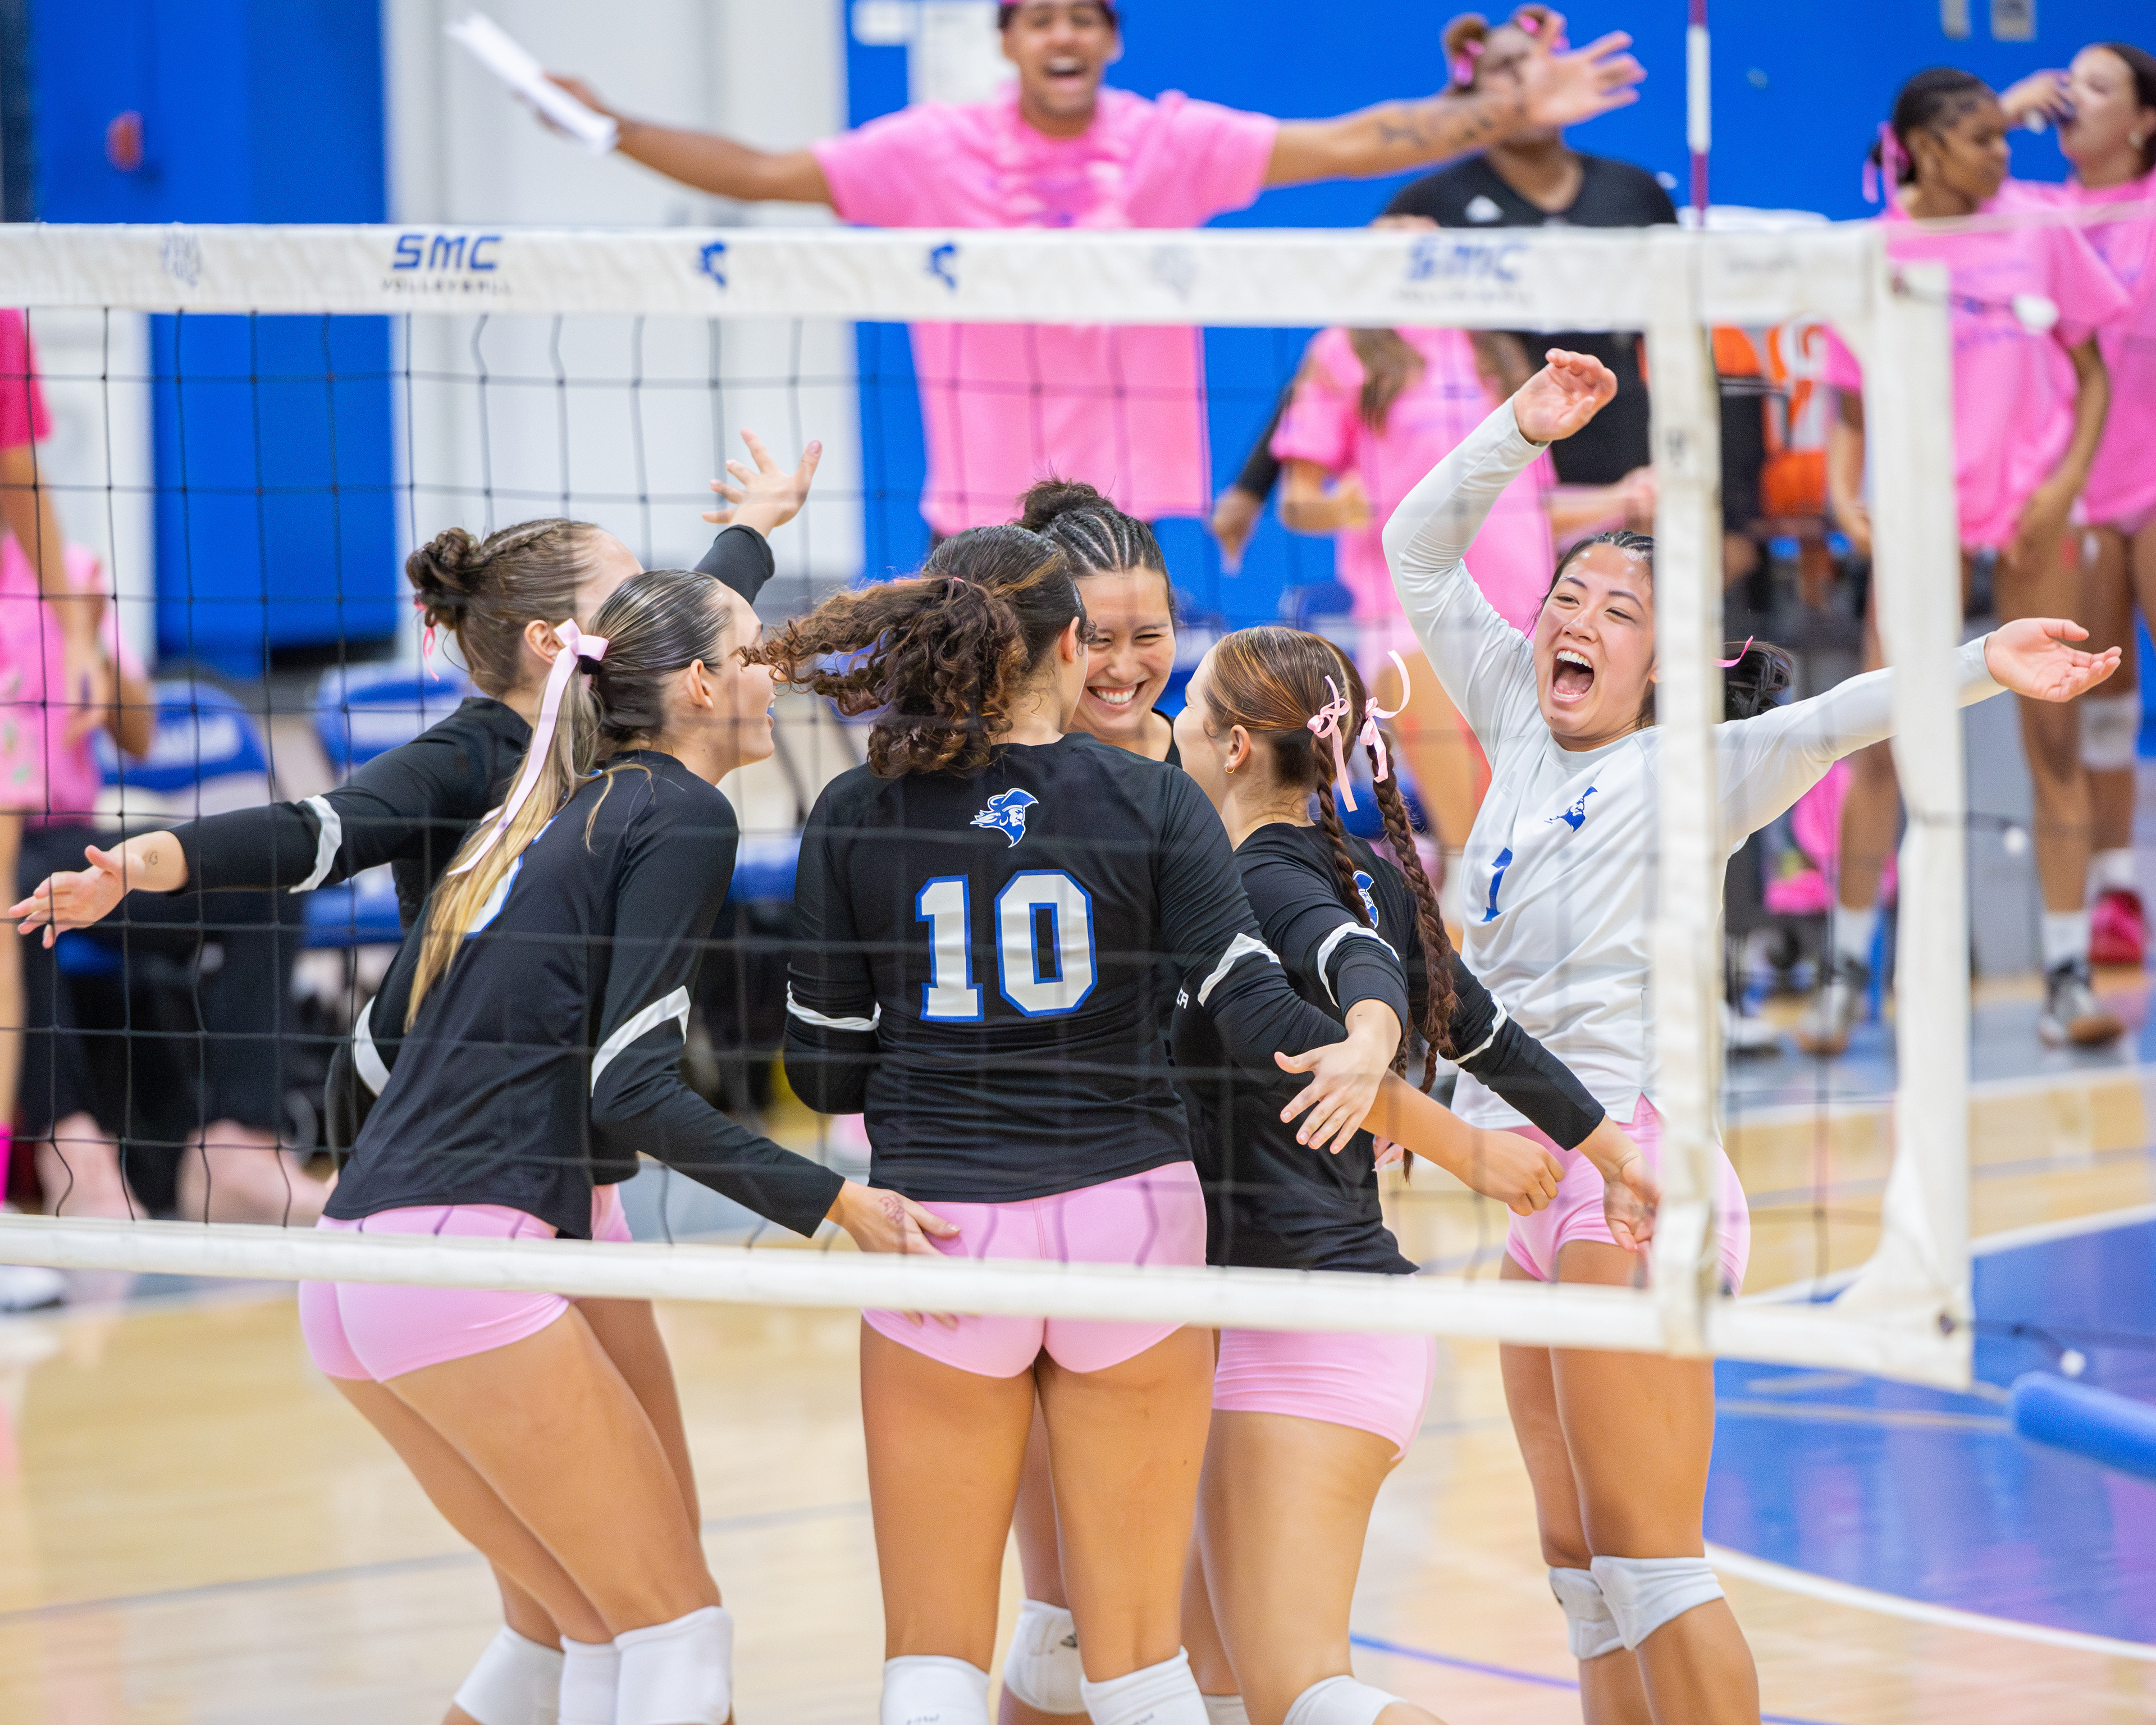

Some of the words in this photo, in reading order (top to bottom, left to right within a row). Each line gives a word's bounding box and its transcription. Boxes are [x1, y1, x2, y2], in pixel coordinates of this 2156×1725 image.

[392, 233, 503, 270] SMC
[1408, 237, 1532, 282] SMC
[1481, 847, 1513, 921] 1
[915, 869, 1098, 1022] 10
